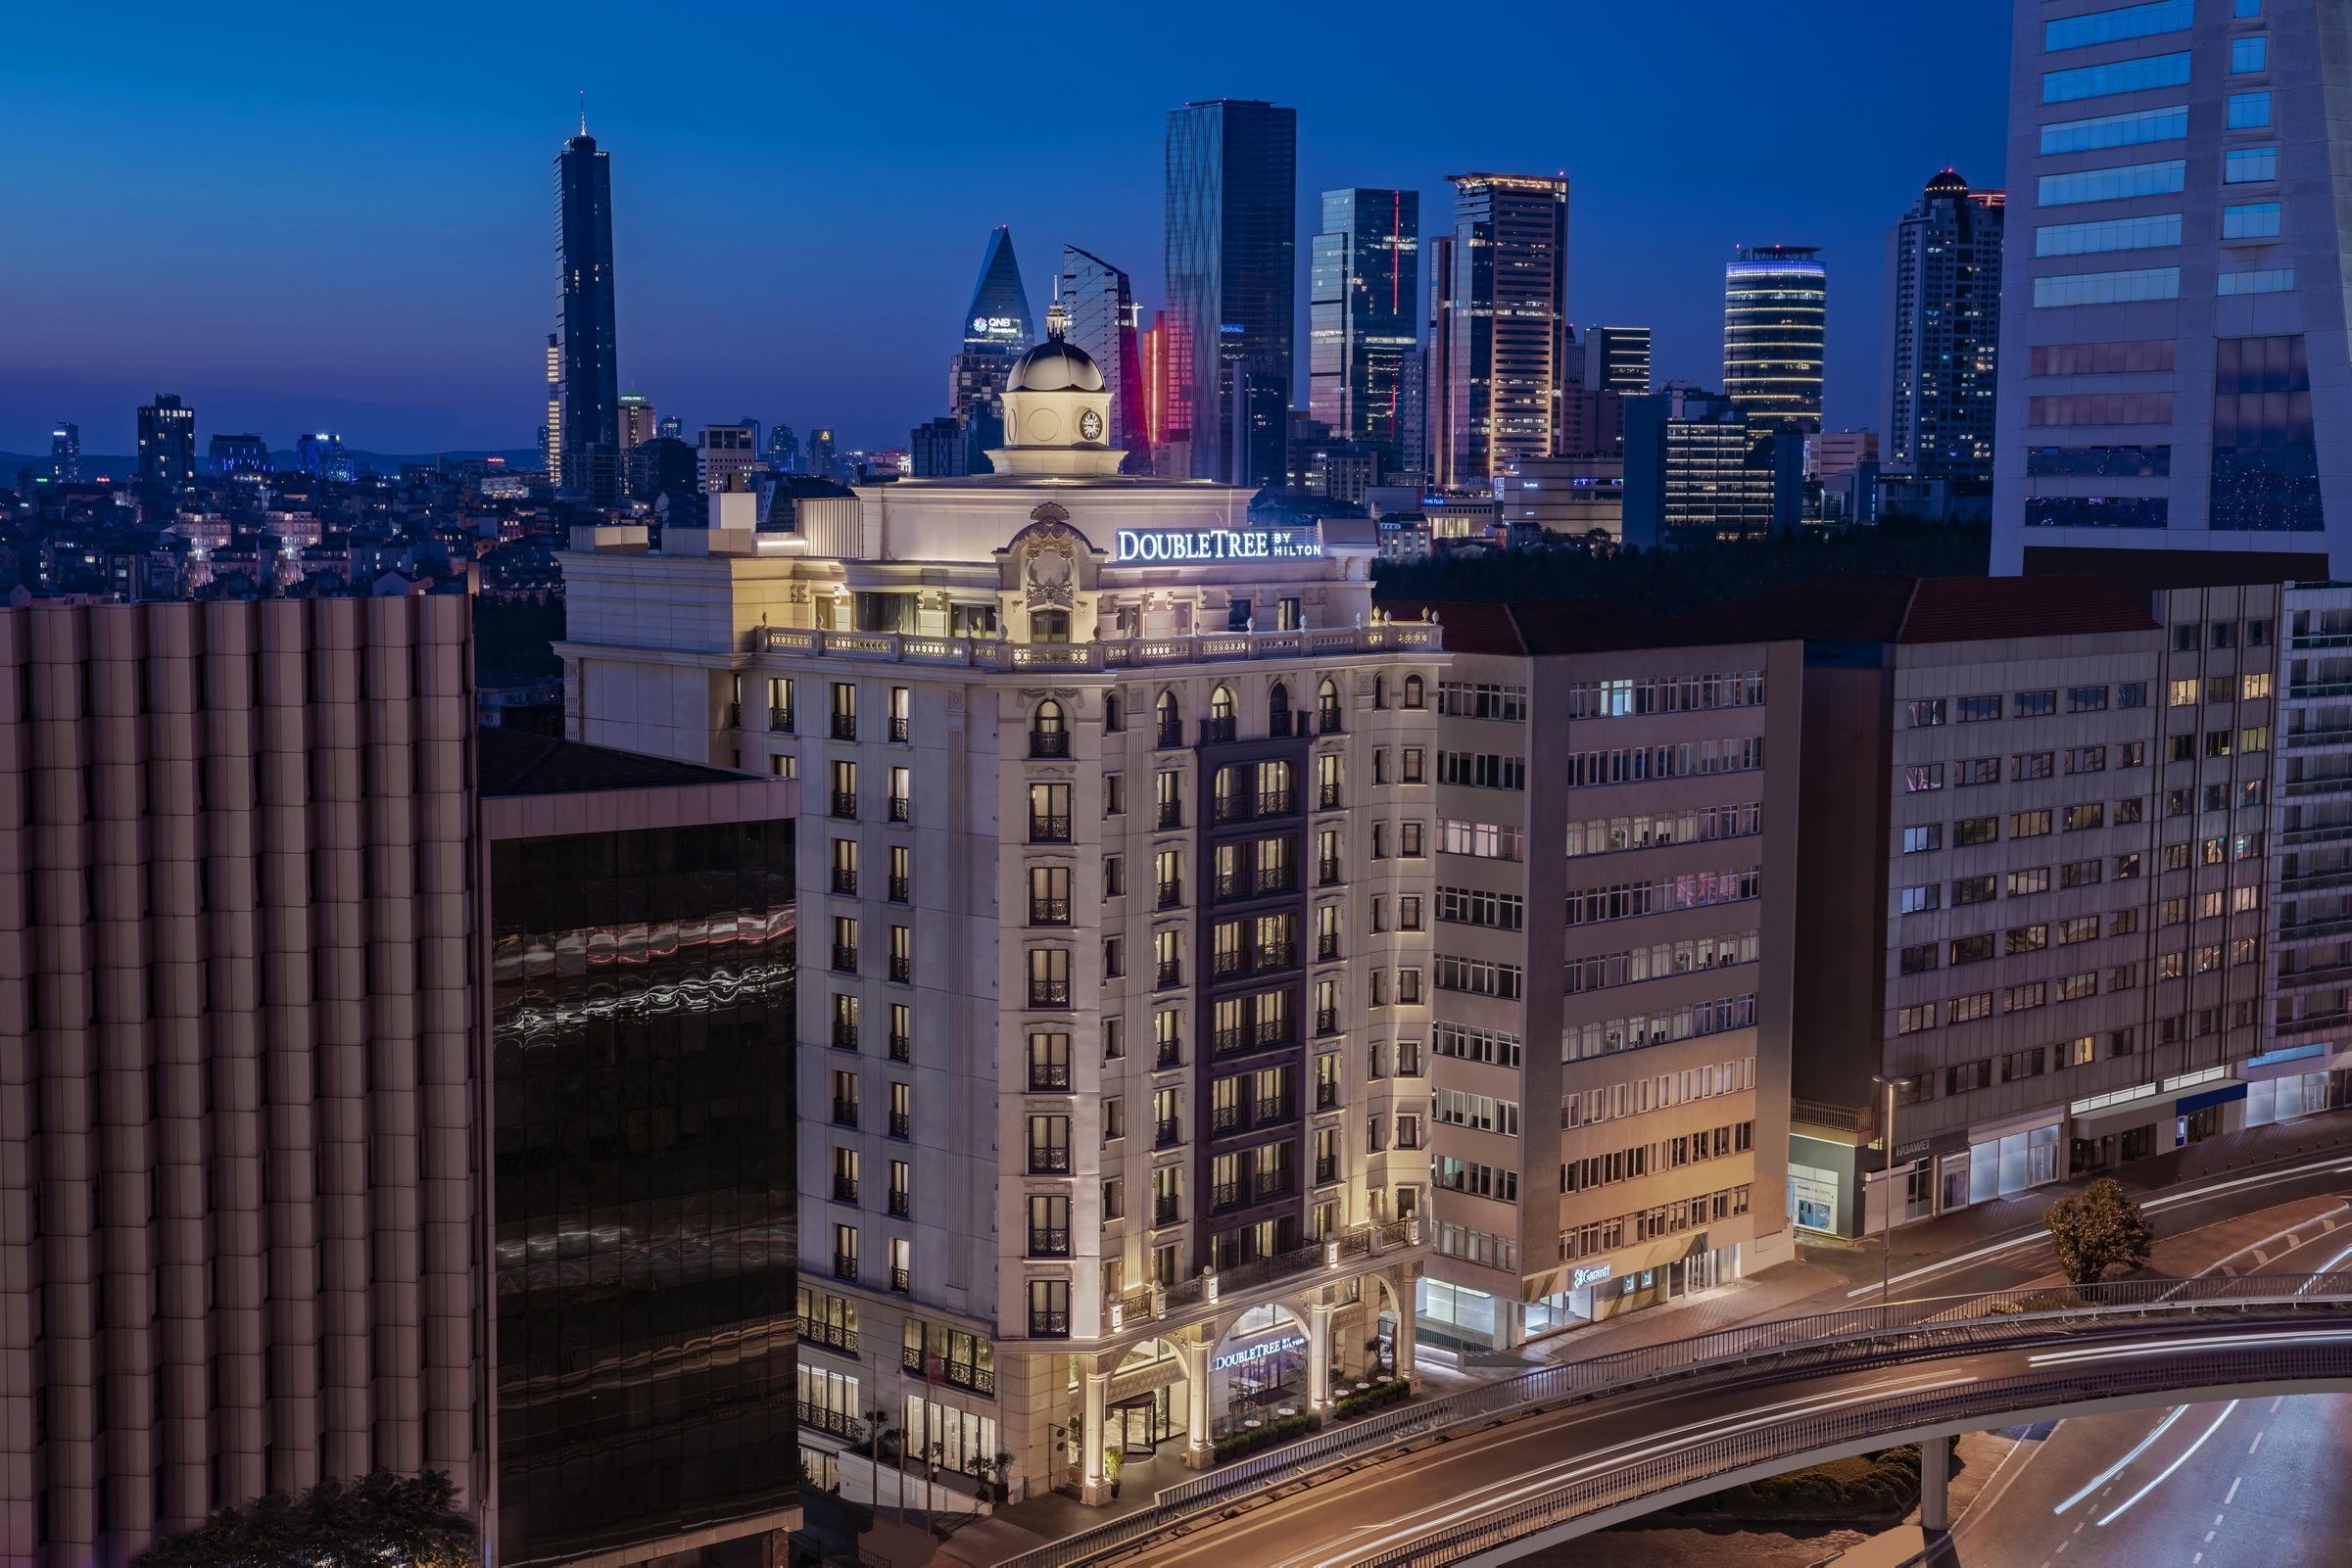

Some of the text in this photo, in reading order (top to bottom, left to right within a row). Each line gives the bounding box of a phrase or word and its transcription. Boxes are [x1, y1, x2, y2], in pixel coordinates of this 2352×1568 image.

[988, 317, 1011, 327] QNB
[1119, 530, 1291, 559] DOUBLETREE BY
[1274, 546, 1321, 556] HILTON
[1896, 1139, 1930, 1157] HUAWEI
[1216, 1341, 1280, 1370] DOUBLETREE
